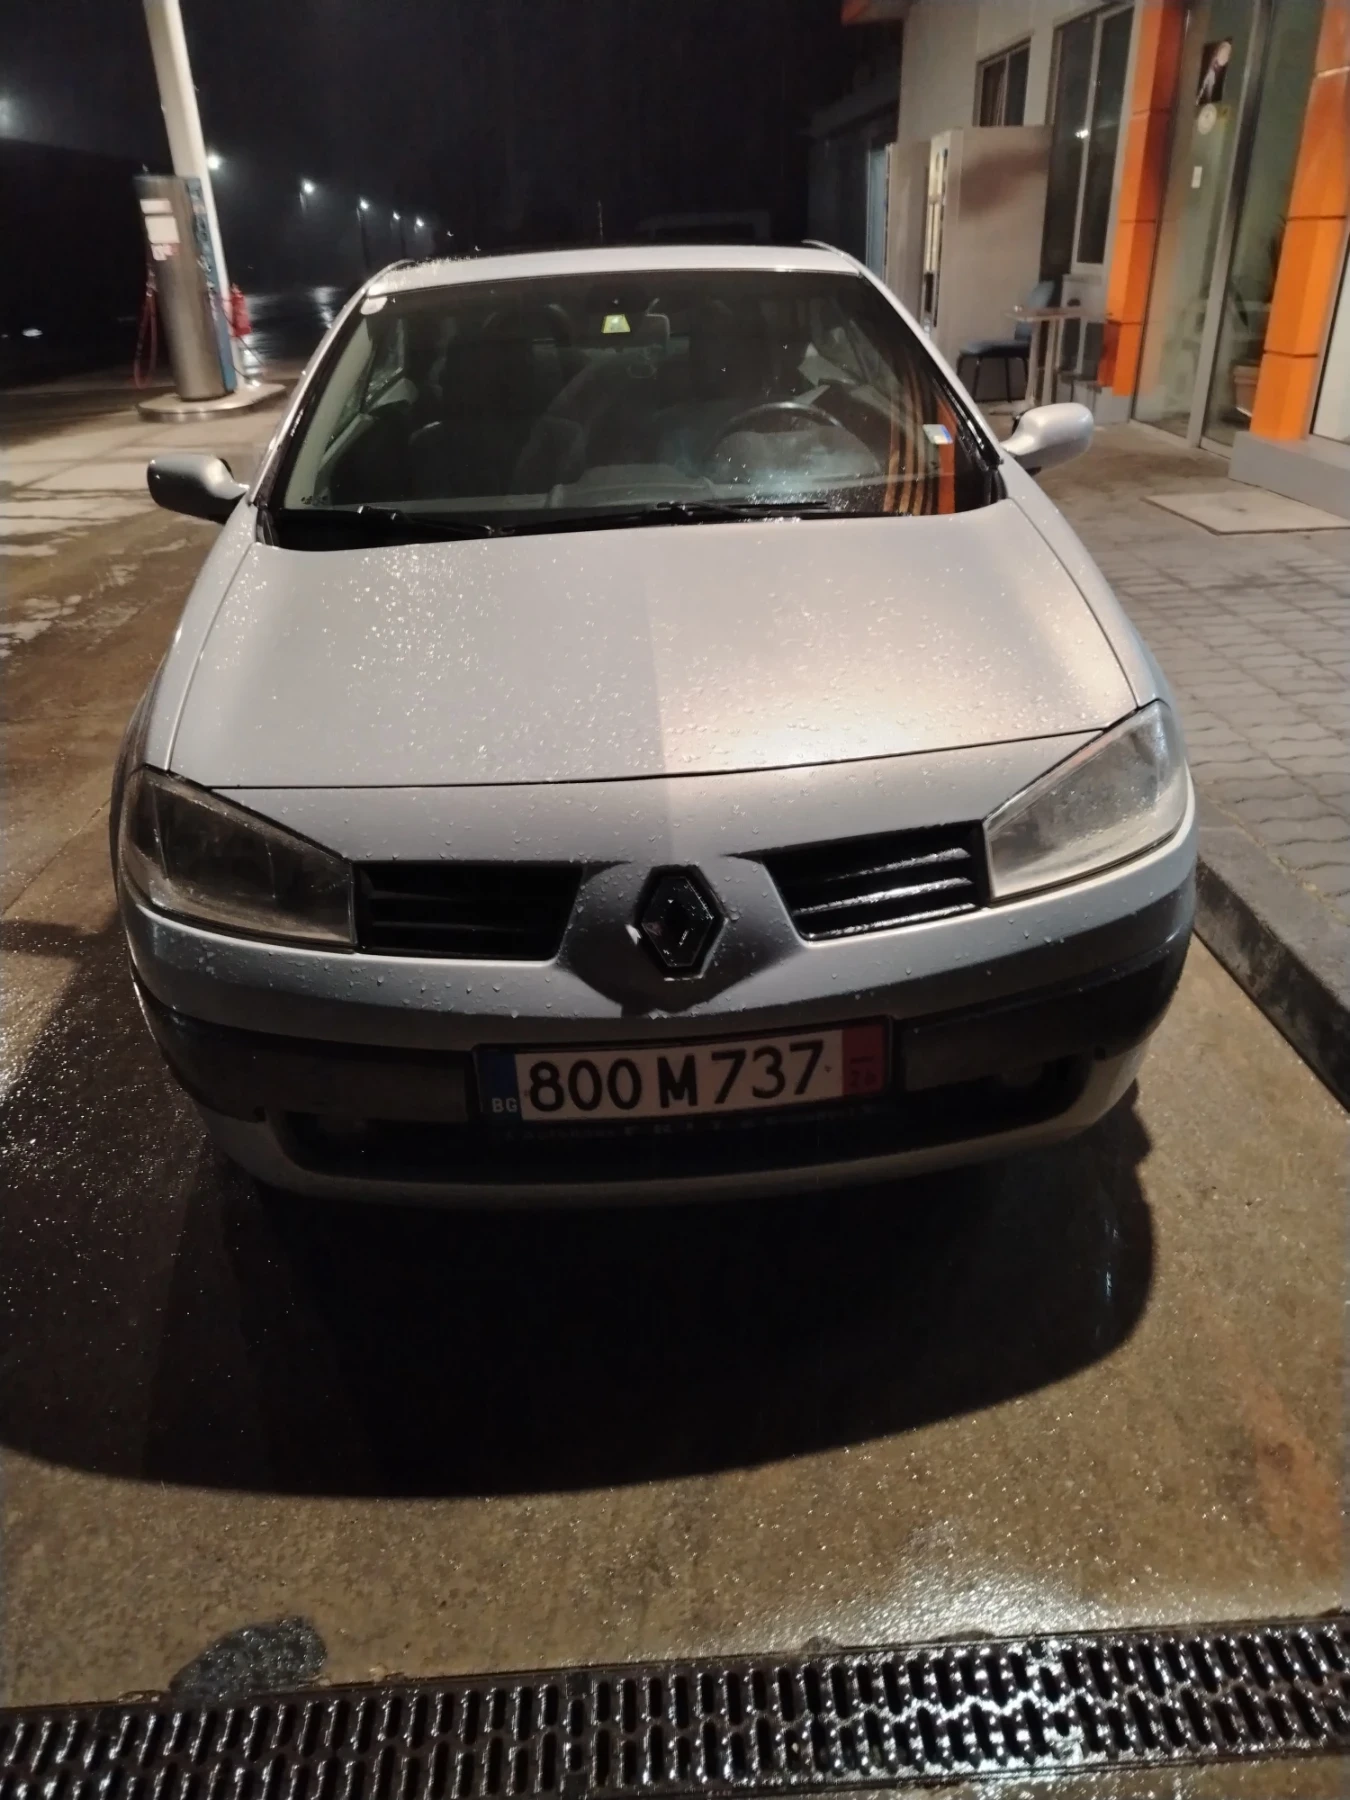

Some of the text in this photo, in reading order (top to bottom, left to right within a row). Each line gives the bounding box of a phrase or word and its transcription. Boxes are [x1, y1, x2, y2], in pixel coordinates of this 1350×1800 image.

[529, 1039, 824, 1112] 800 M 737
[491, 1097, 518, 1113] BG
